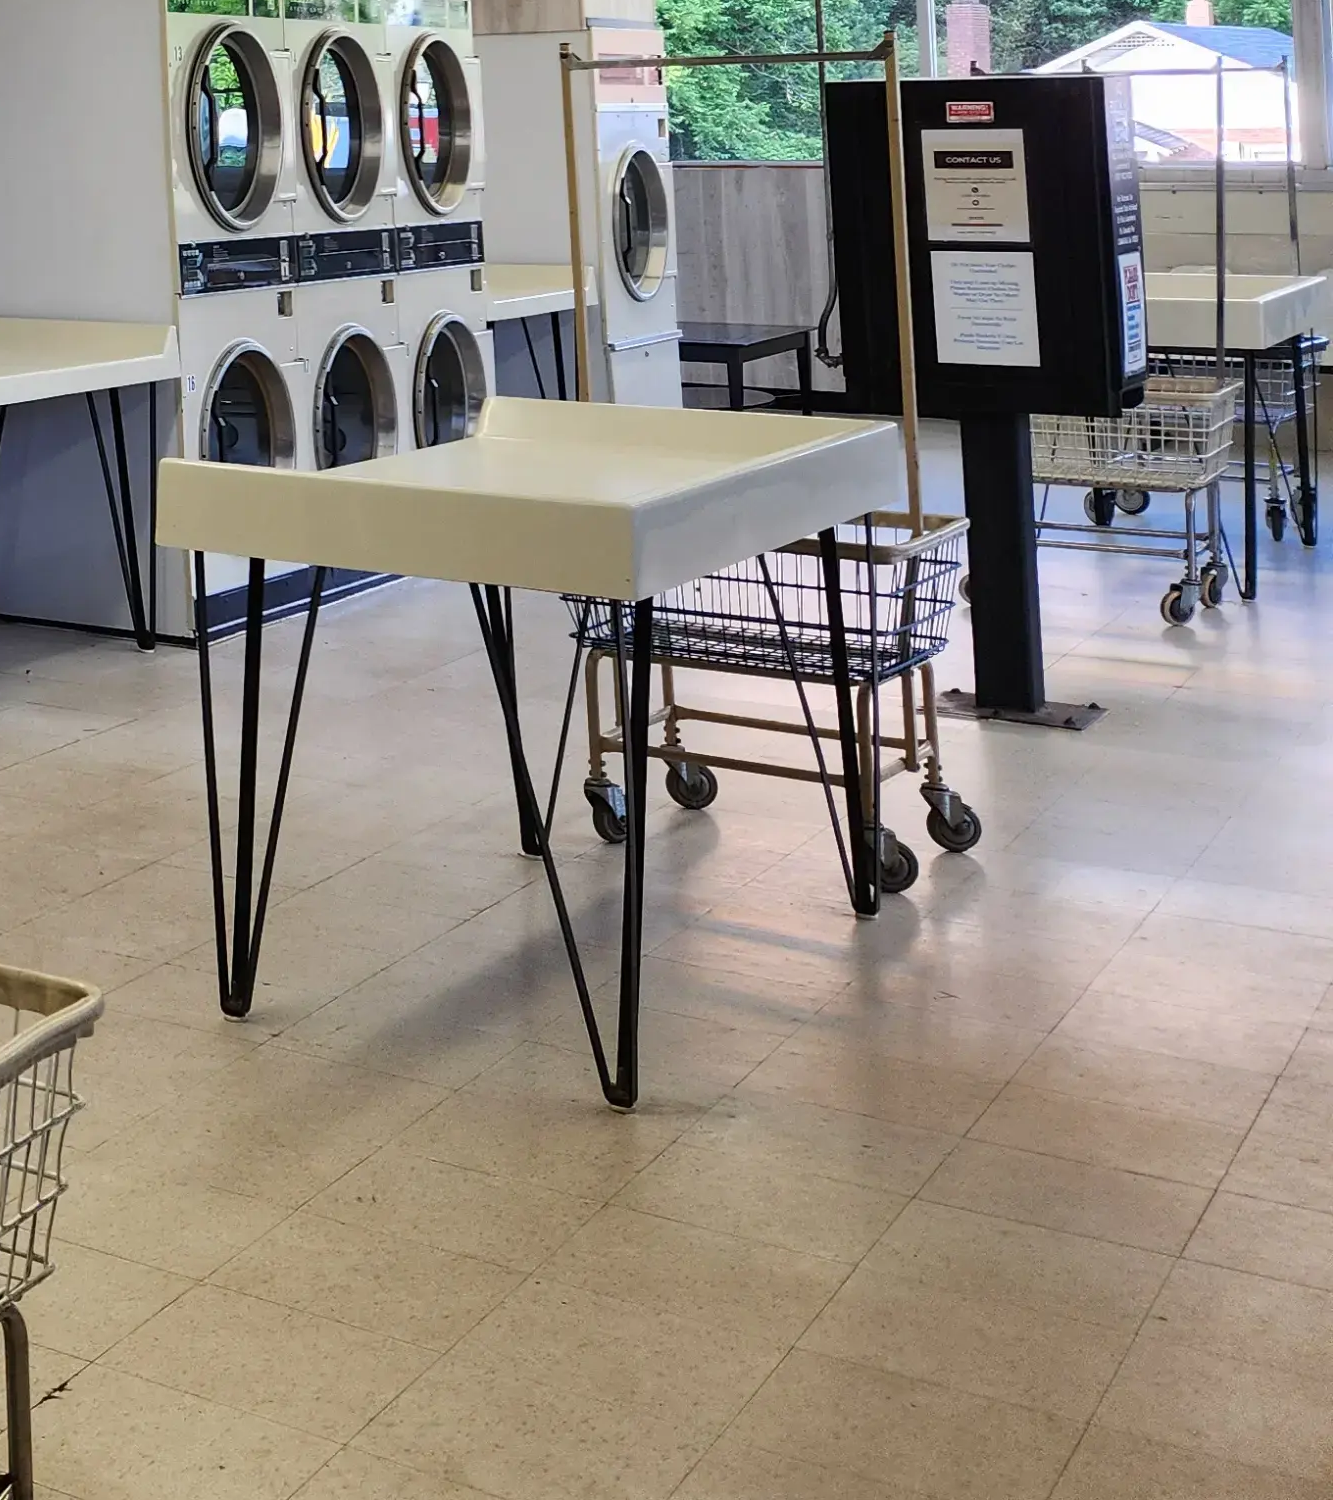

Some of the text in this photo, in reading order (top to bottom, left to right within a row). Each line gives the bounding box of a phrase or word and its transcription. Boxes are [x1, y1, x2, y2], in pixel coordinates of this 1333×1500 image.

[174, 46, 182, 62] 13
[946, 156, 1002, 164] CONTACT US
[188, 375, 196, 392] 16
